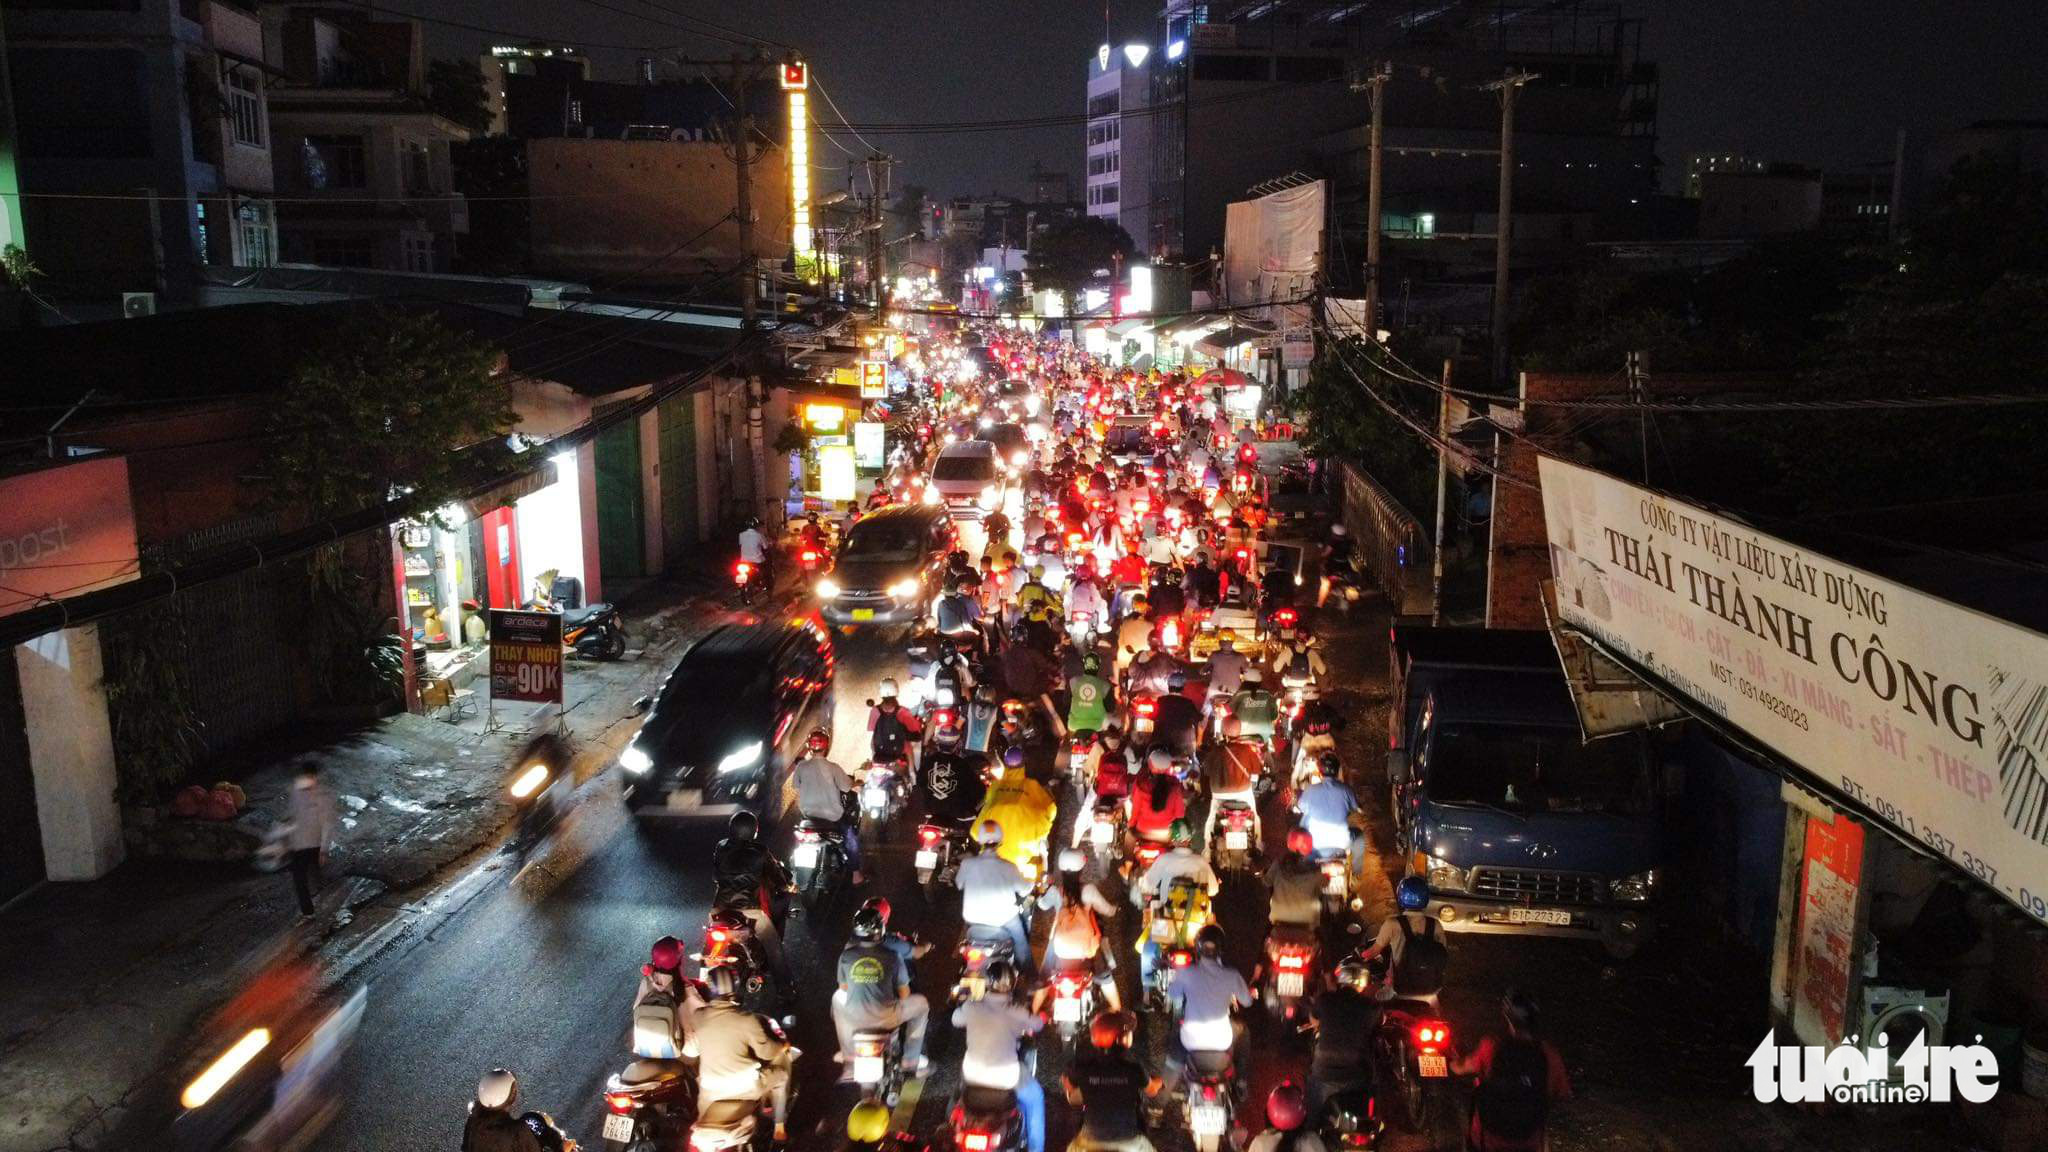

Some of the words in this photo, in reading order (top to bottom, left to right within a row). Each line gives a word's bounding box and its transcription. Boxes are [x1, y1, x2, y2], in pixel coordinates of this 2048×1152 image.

[1640, 496, 1677, 537] CÔNG
[1679, 514, 1697, 546] TY
[1701, 520, 1731, 563] VẬT
[1735, 536, 1776, 582] LIỆU
[1780, 552, 1818, 598] XÂY
[1823, 572, 1888, 627] DỰNG
[494, 645, 522, 661] THAY
[527, 645, 560, 665] NHỚT
[1604, 526, 1676, 593] THÁI
[1682, 560, 1818, 665] THÀNH
[1830, 632, 1986, 749] CÔNG
[1710, 659, 1738, 692] MST:
[1739, 677, 1808, 732] 0314923023
[1706, 625, 1731, 662] CÁT
[1745, 647, 1767, 684] ĐÁ
[1780, 666, 1798, 701] XI
[1802, 676, 1853, 730] MĂNG
[1869, 708, 1906, 762] SẮT
[1927, 743, 1993, 804] THÉP
[1841, 775, 1871, 807] ĐT:
[1875, 796, 1916, 835] 0911
[1922, 825, 1955, 860] 337
[1962, 850, 1998, 886] 337
